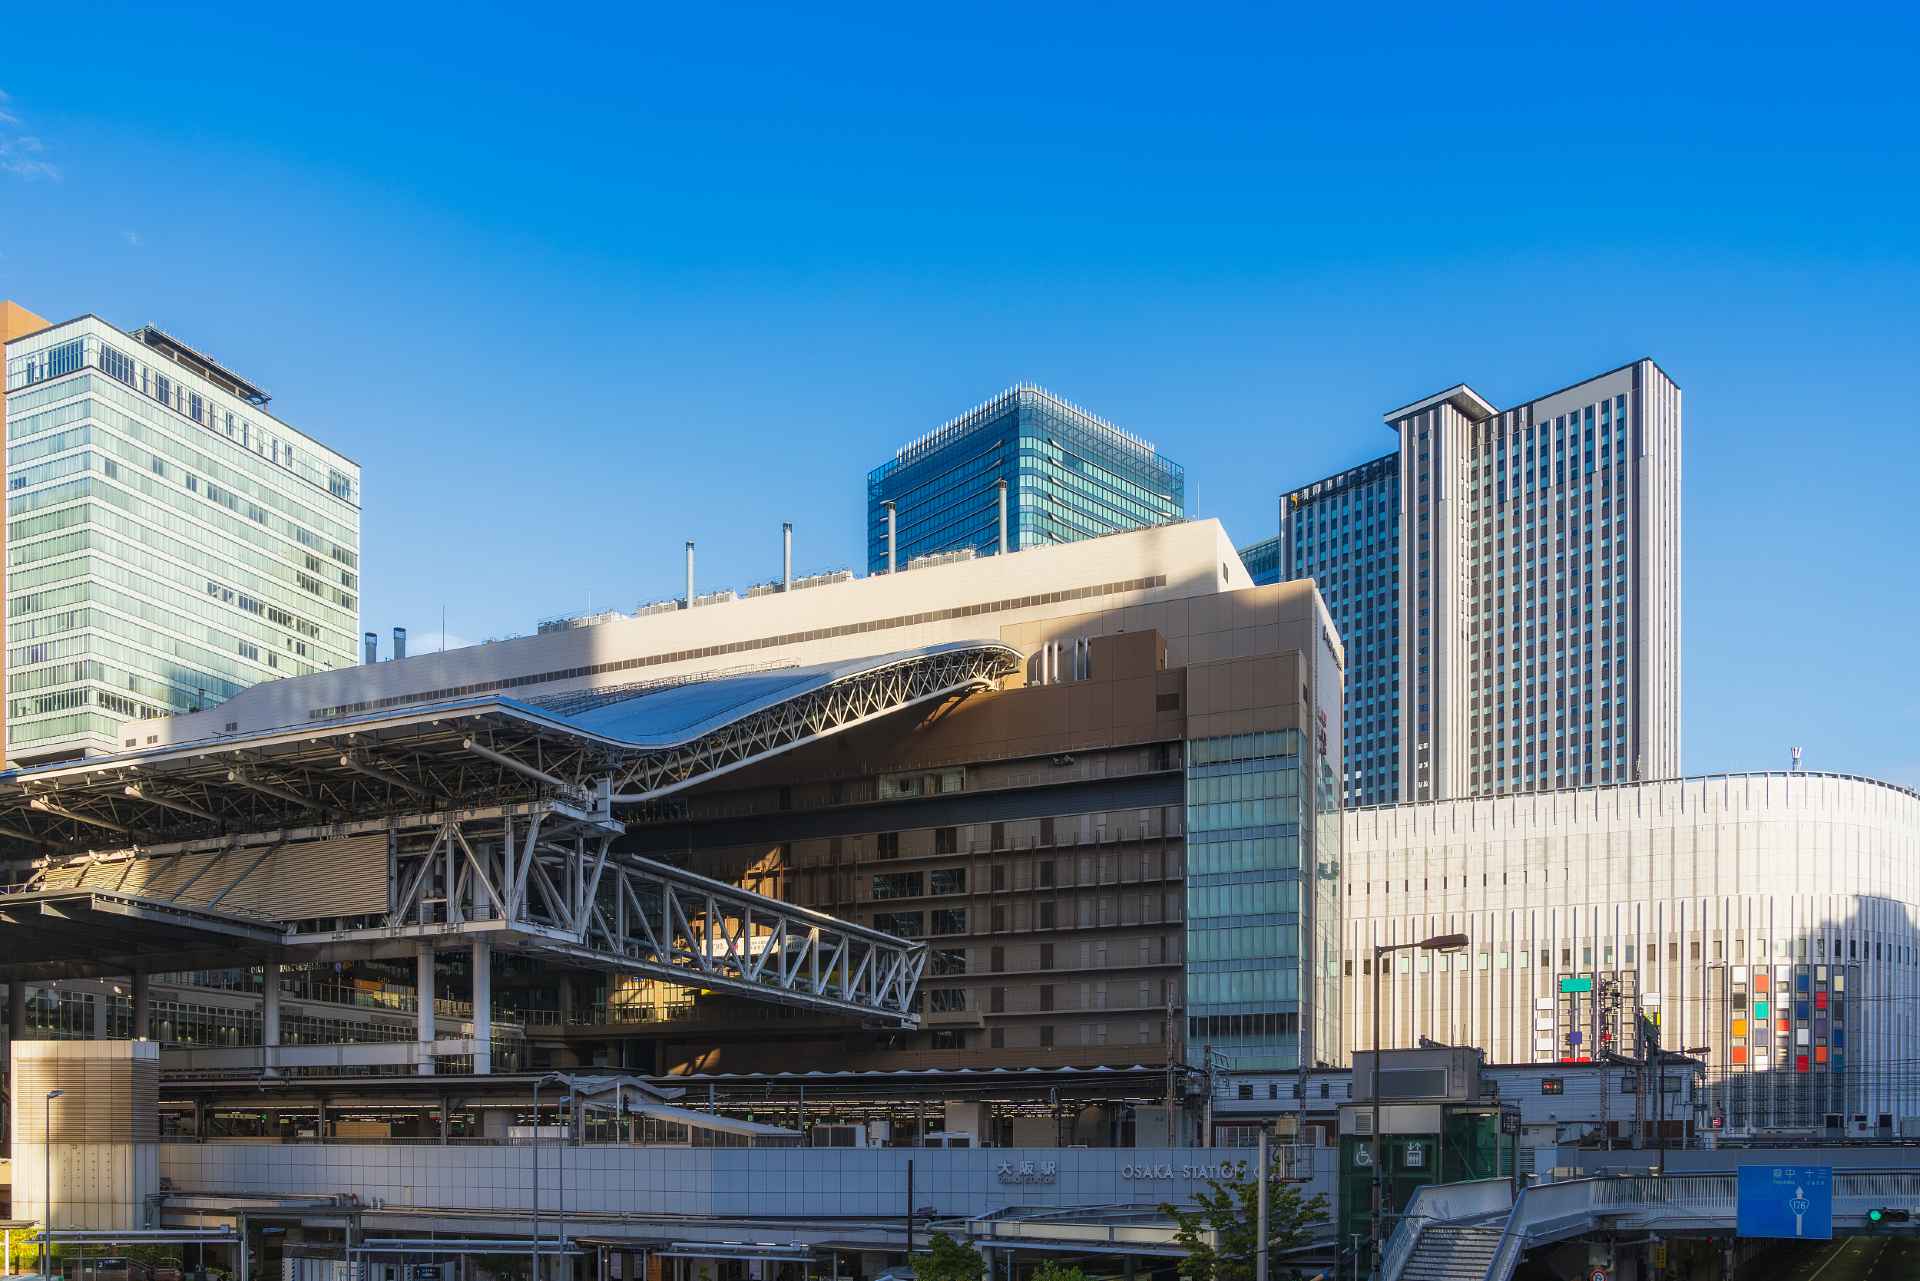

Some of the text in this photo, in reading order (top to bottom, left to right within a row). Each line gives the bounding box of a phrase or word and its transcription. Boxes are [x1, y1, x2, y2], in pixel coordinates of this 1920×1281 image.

[998, 1160, 1056, 1176] 大阪駅
[1122, 1163, 1175, 1179] OSAKA
